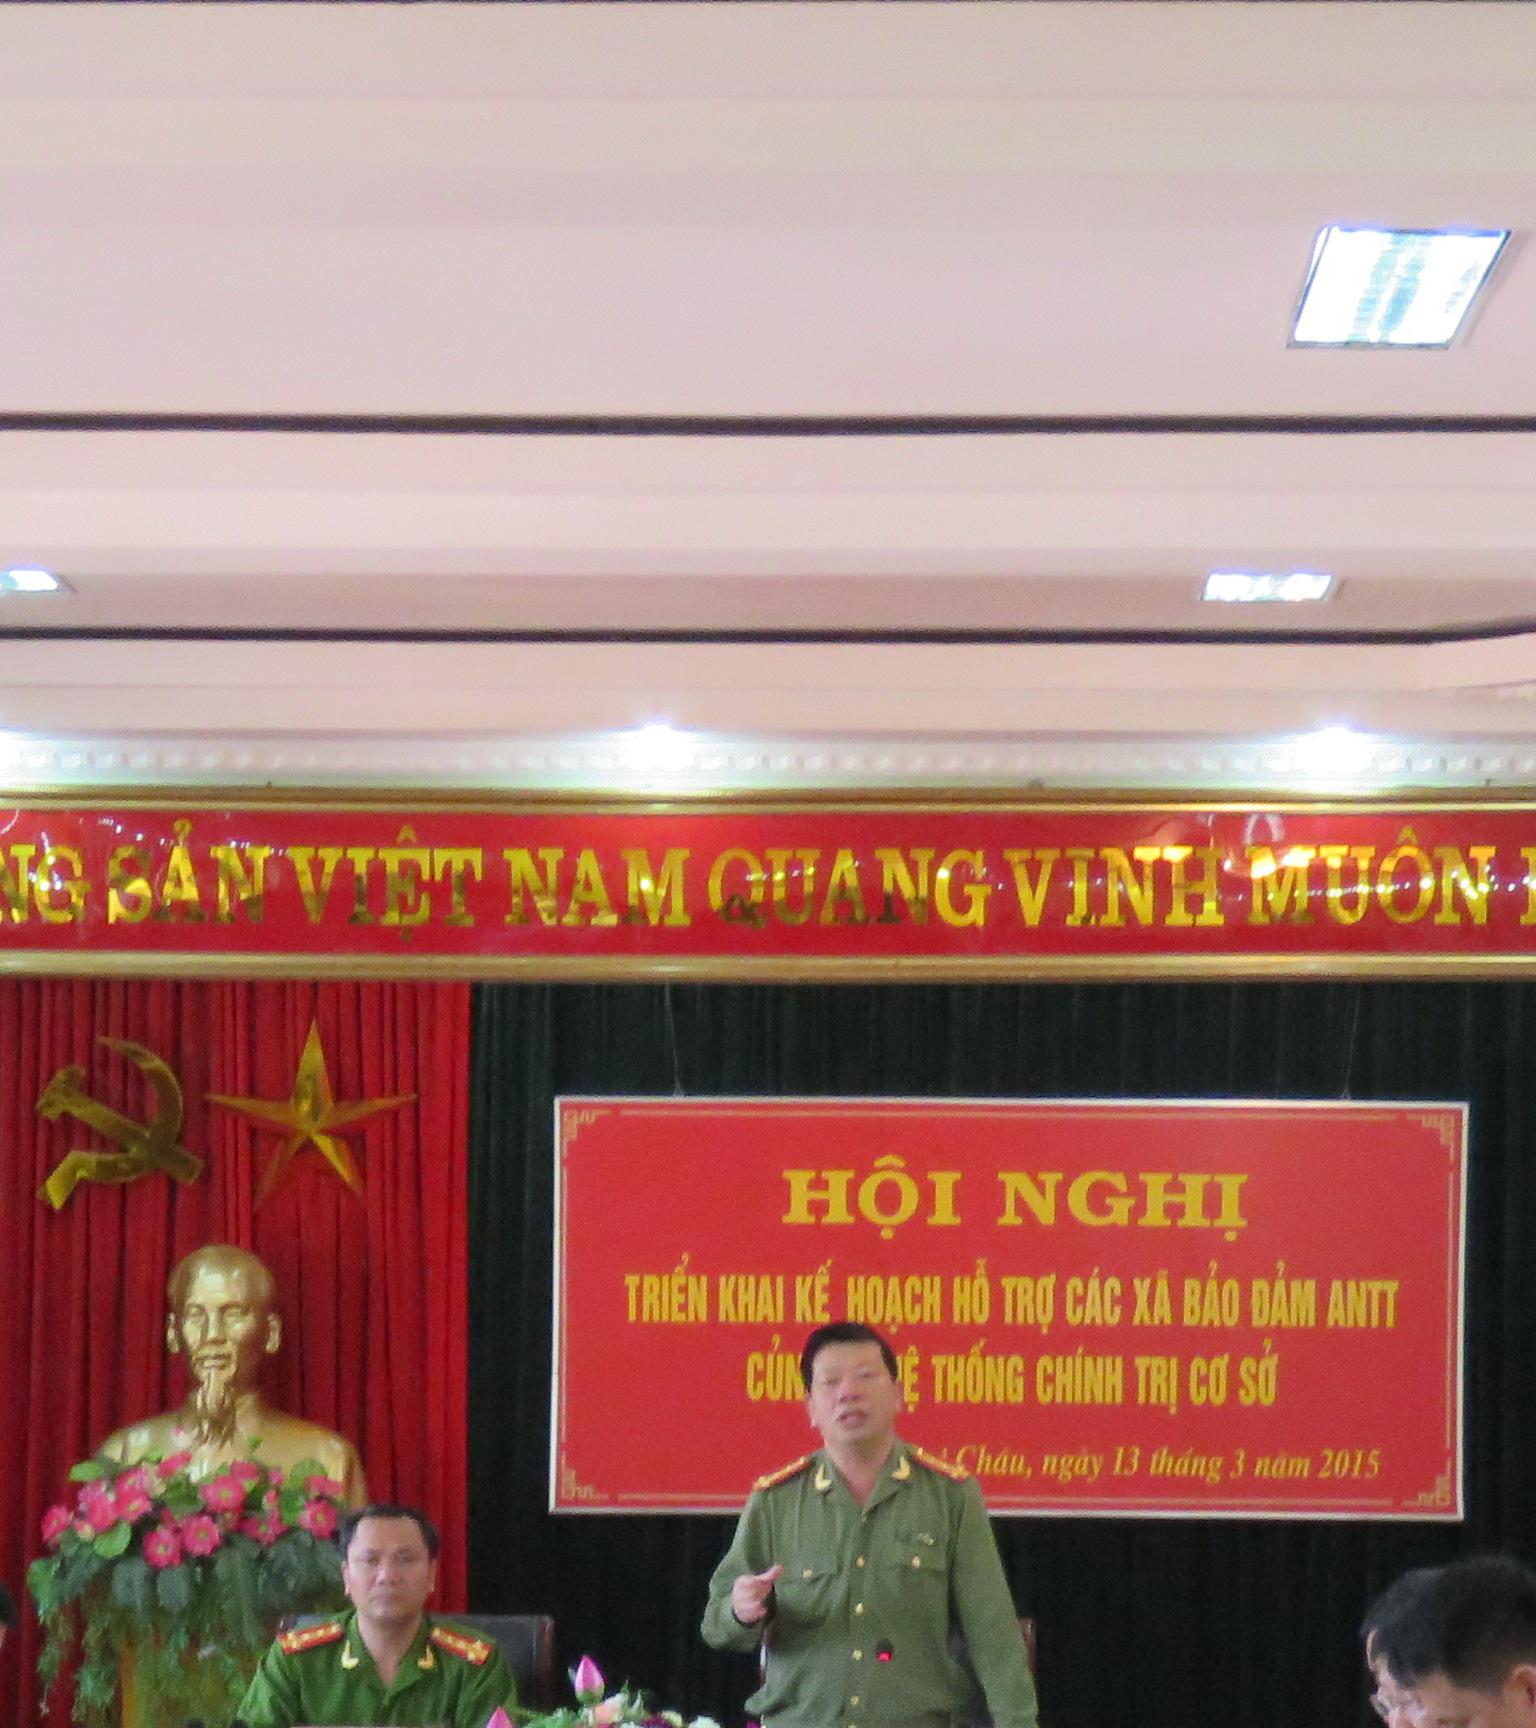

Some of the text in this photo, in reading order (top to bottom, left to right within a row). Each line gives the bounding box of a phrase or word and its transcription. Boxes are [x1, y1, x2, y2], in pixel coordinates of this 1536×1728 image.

[107, 820, 273, 923] SẢN
[286, 826, 484, 941] VIỆT
[502, 847, 691, 926] NAM
[707, 848, 992, 927] QUANG
[1004, 845, 1226, 927] VINH
[1244, 826, 1491, 925] MUÔN
[784, 1155, 1249, 1242] HỘI NGHỊ
[625, 1252, 1400, 1335] TRIỂN KHAI KẾ HOẠCH HỖ TRỢ CÁC XÃ BẢO ĐẢM ANTT
[932, 1342, 1025, 1403] THỐNG
[1036, 1348, 1124, 1404] CHÍNH
[1135, 1356, 1179, 1413] TRỊ
[1189, 1355, 1230, 1406] CƠ
[1238, 1339, 1279, 1406] SỞ
[1040, 1450, 1108, 1486] ngày
[1112, 1444, 1144, 1476] 13
[1150, 1446, 1226, 1486] tháng
[1230, 1446, 1248, 1478] 3
[1252, 1450, 1314, 1480] năm
[1318, 1448, 1384, 1482] 2015
